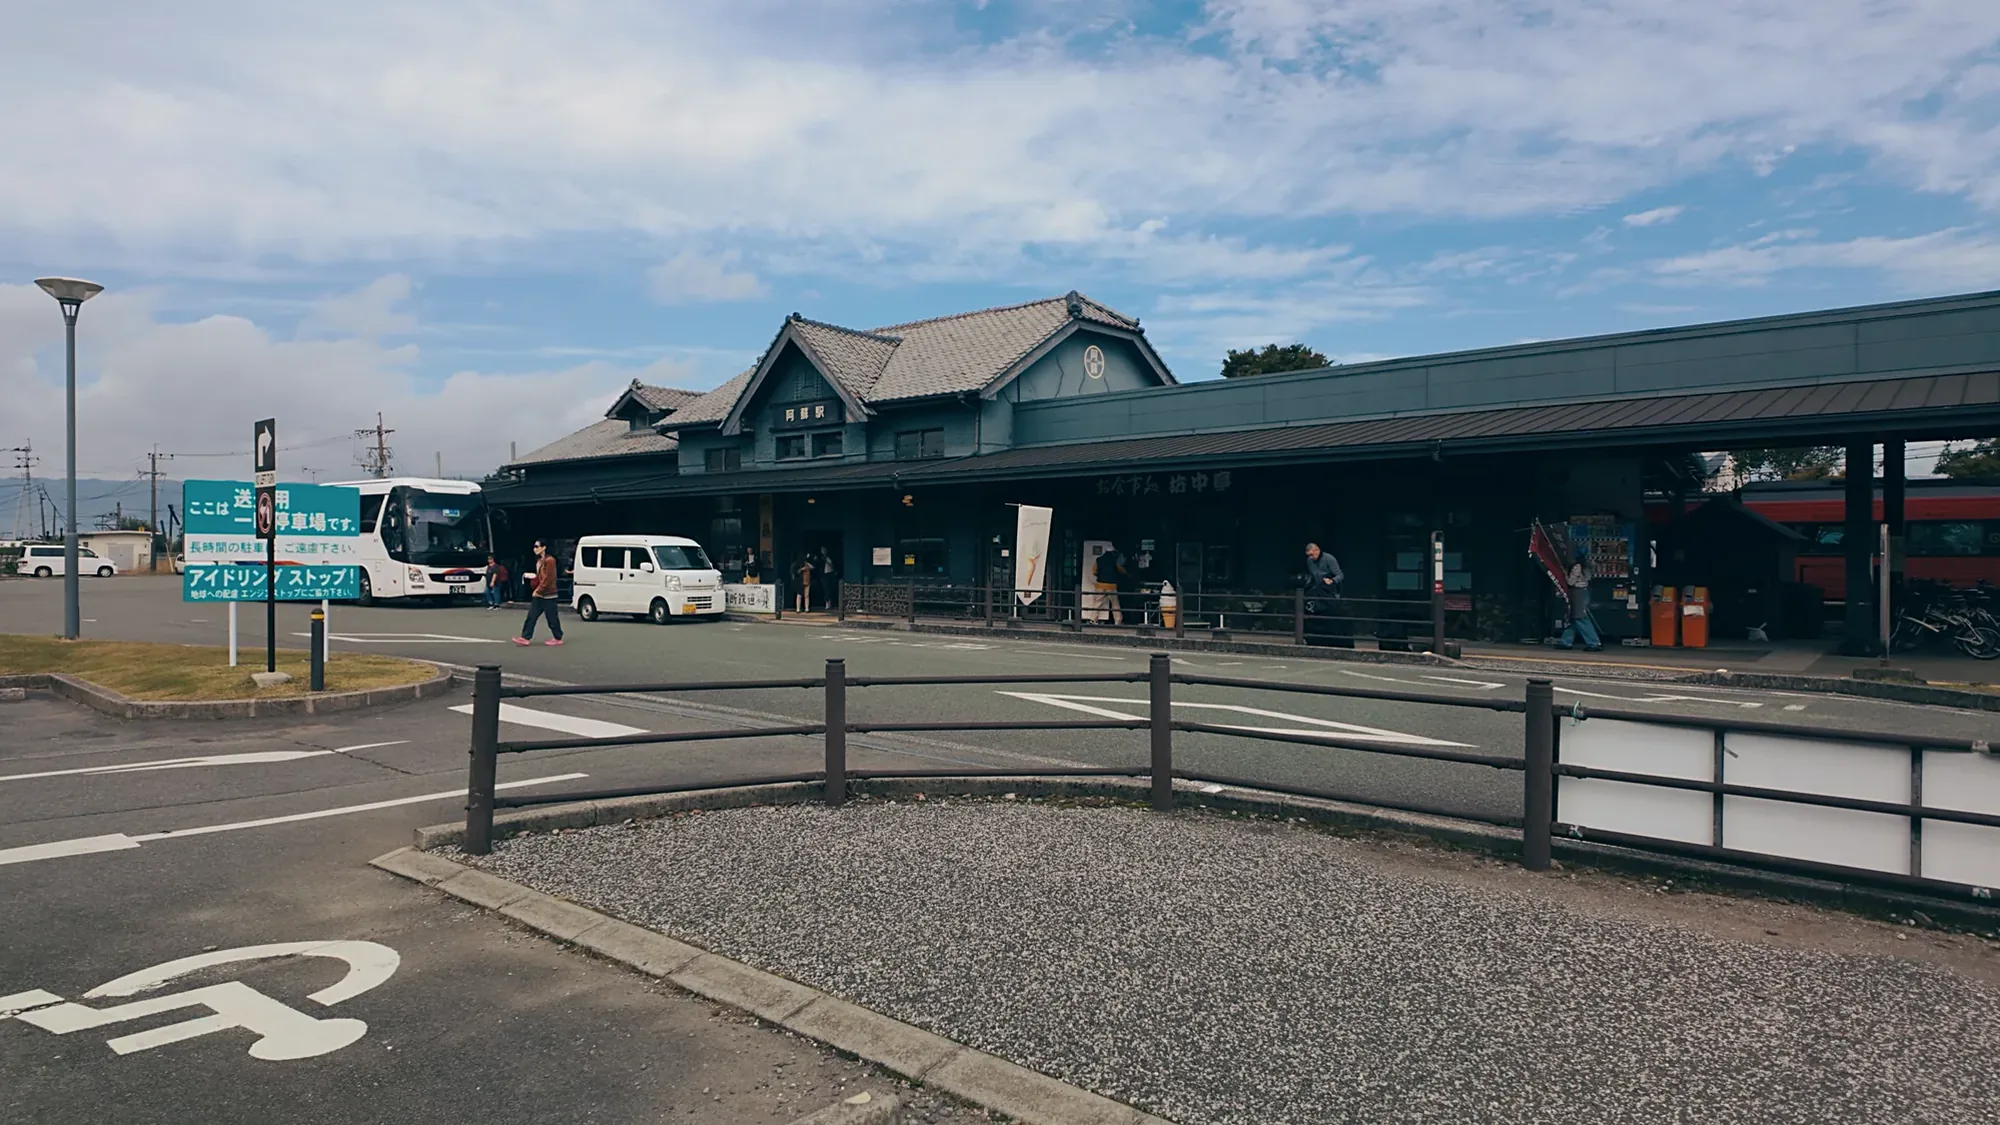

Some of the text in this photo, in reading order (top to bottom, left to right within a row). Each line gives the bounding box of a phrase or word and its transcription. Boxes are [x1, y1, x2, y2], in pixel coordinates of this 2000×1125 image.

[233, 488, 290, 510] 送用
[189, 501, 230, 516] ここは
[234, 511, 356, 532] 一停車場です。
[190, 541, 356, 554] 長時間の駐車、ご遠慮下さい。
